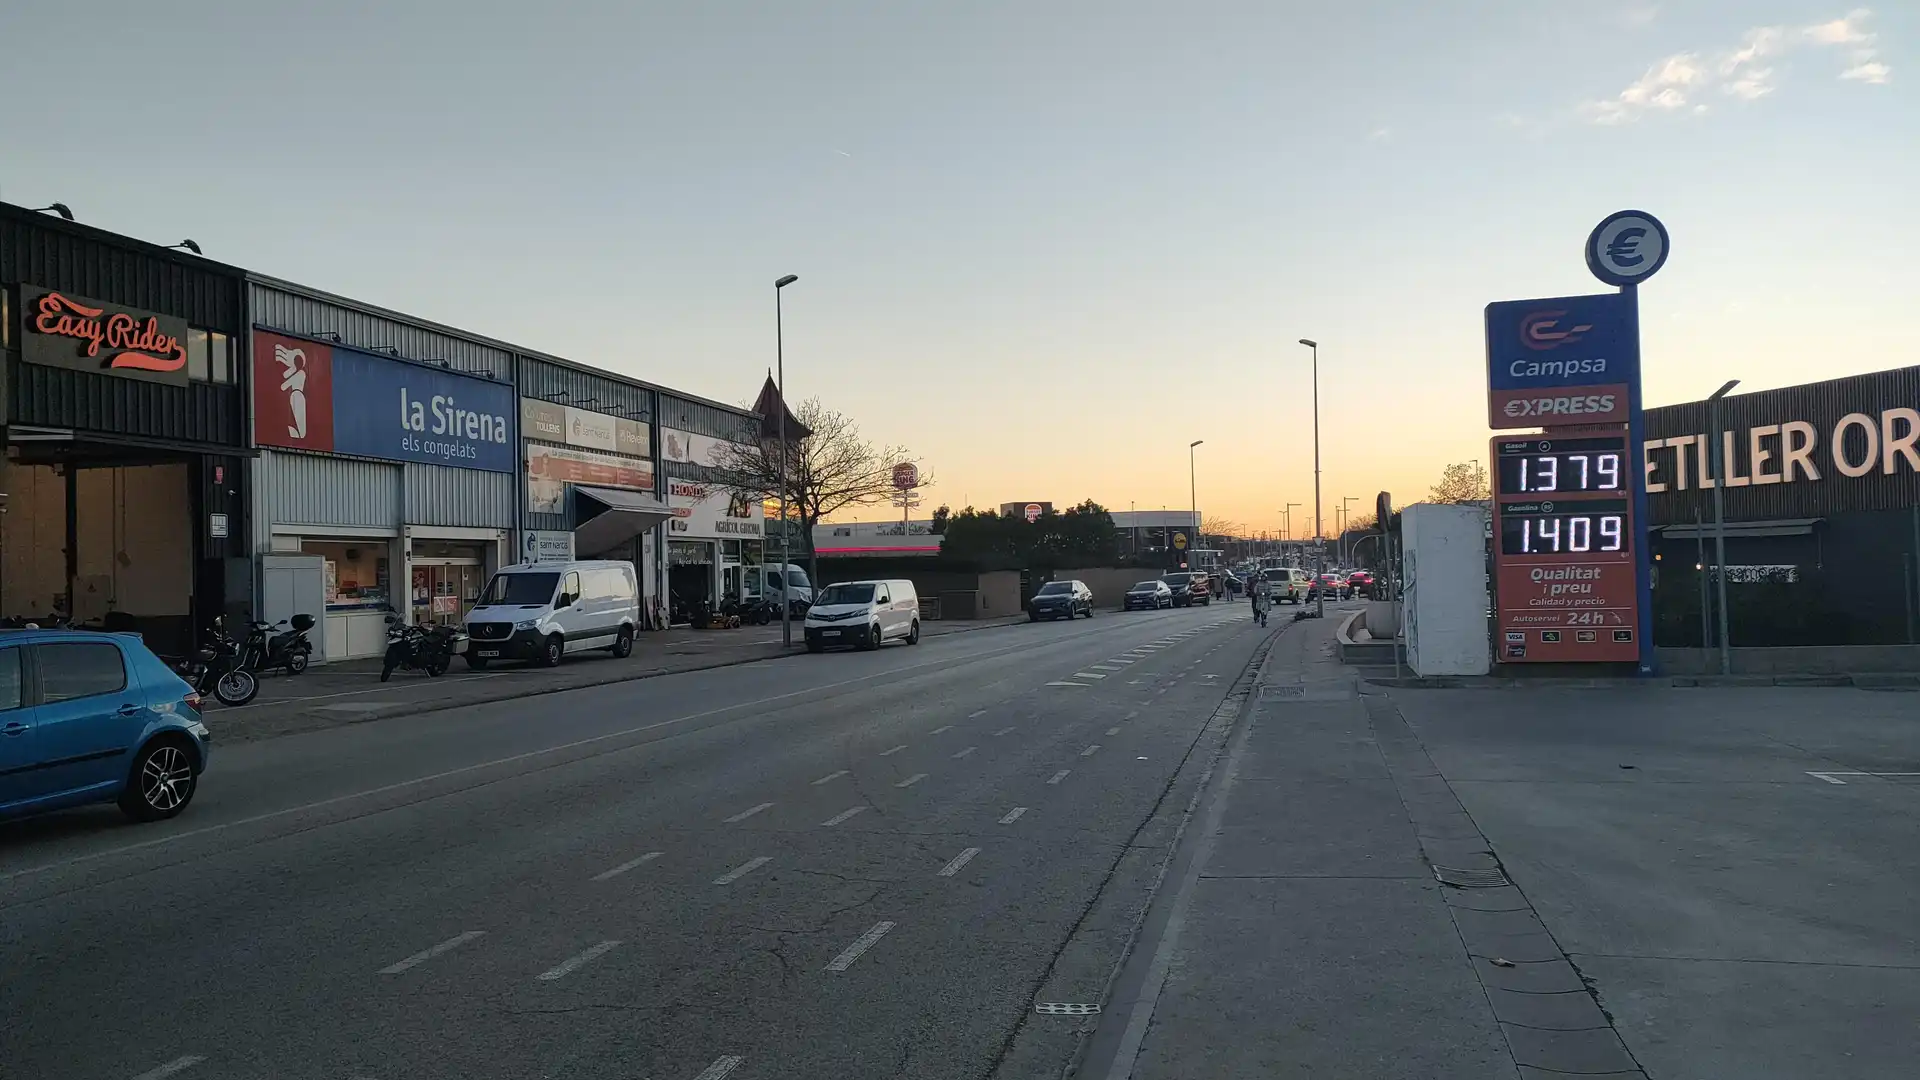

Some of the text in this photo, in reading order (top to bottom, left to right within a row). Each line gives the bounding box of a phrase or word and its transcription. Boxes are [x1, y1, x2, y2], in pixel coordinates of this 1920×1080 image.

[36, 293, 186, 371] Easy Rider
[1510, 358, 1606, 378] Campsa
[401, 388, 506, 444] la Sirena
[535, 421, 560, 434] TOLLENS
[402, 434, 476, 460] els congelats
[1505, 442, 1528, 450] Gasoil
[1520, 455, 1618, 491] 1.379
[671, 484, 707, 498] HOND
[1508, 504, 1538, 512] Gasolina
[1523, 516, 1621, 552] 1.409
[1531, 566, 1601, 583] Qualitat
[1543, 583, 1592, 596] i preu
[1529, 598, 1564, 606] Calidad
[1575, 597, 1605, 606] precio
[1513, 612, 1604, 625] Autoservei 24h
